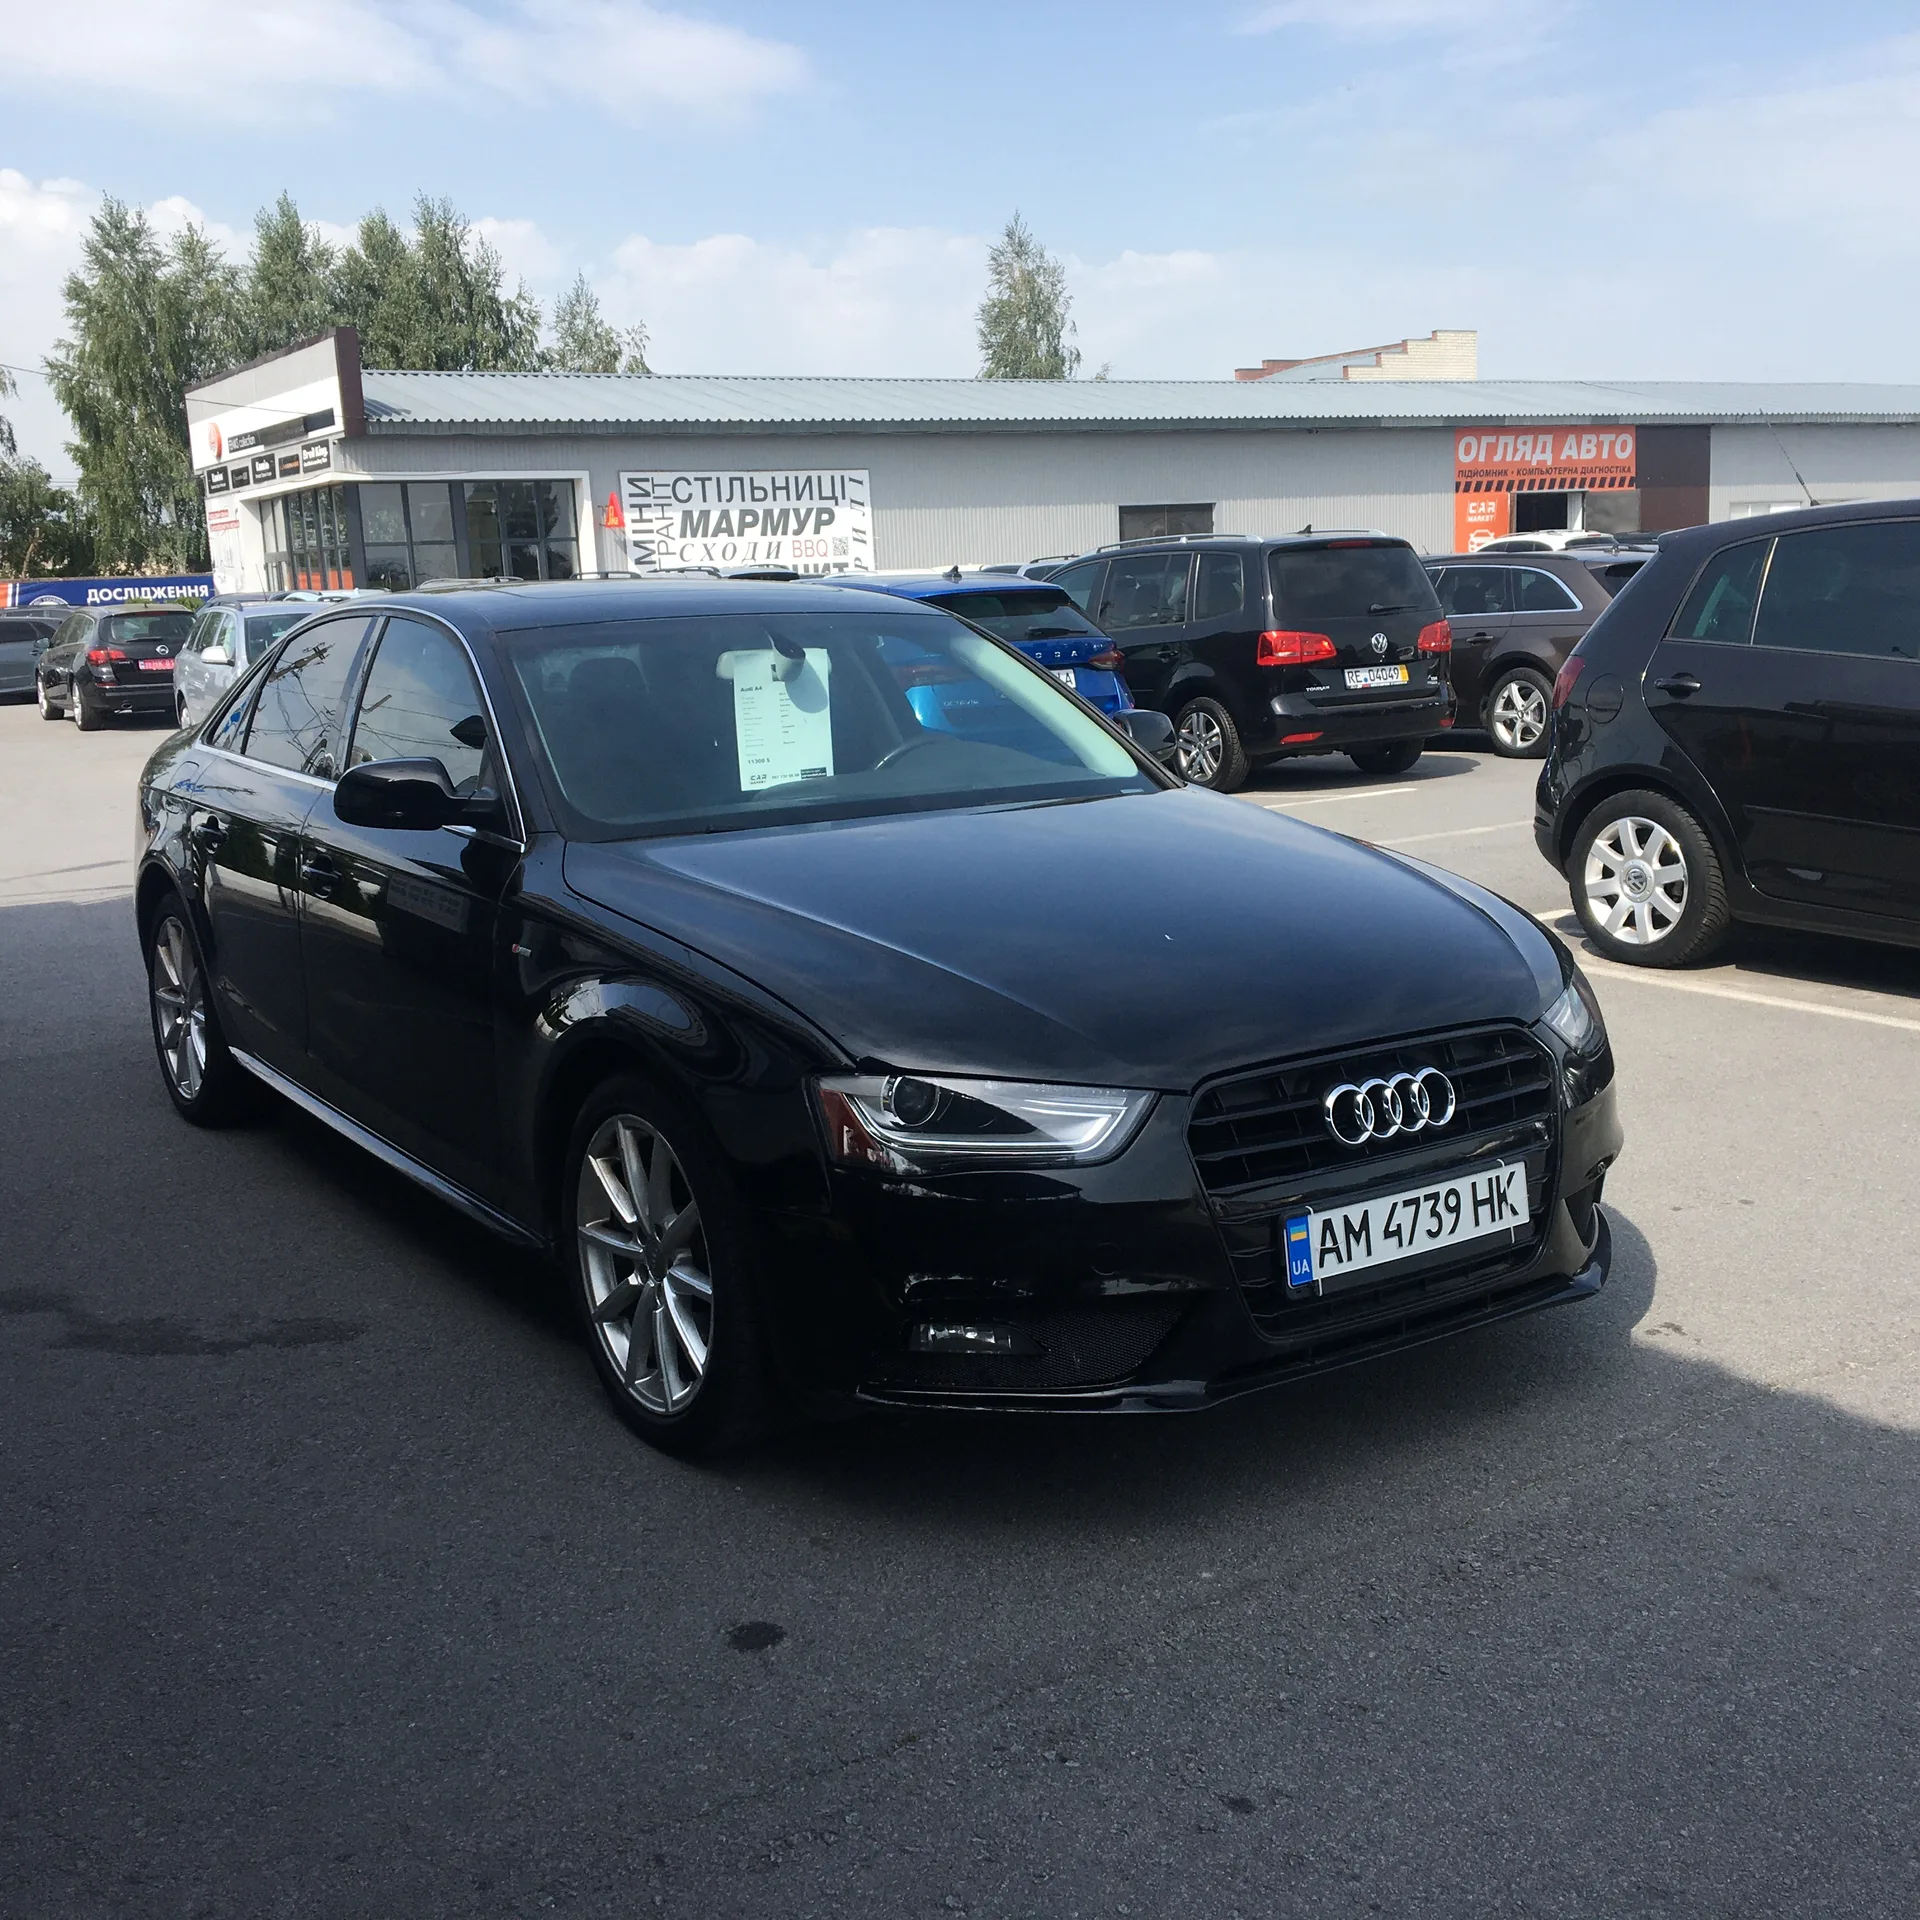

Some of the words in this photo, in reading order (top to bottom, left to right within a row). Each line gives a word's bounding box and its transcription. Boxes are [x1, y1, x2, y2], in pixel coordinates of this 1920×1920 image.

[1458, 434, 1553, 465] ОГЛЯД
[1560, 433, 1633, 460] АВТО
[1457, 468, 1509, 479] ПІДЙОМНИК
[1580, 464, 1631, 475] ДІАГНОСТІКА
[671, 475, 847, 506] СТІЛЬНИЦІ
[1467, 514, 1495, 523] MARKET
[1468, 501, 1496, 515] CAR
[627, 477, 657, 566] МІНИ
[679, 507, 836, 539] МАРМУР
[679, 541, 782, 563] СХОДИ
[792, 538, 829, 558] BBQ
[86, 584, 210, 606] ДОСЛІДЖЕННЯ
[1347, 670, 1363, 685] RE
[1369, 666, 1400, 683] 04049
[1318, 1208, 1373, 1269] AM
[1383, 1186, 1462, 1250] 4739
[1471, 1169, 1520, 1228] HK
[1292, 1257, 1311, 1276] UA
